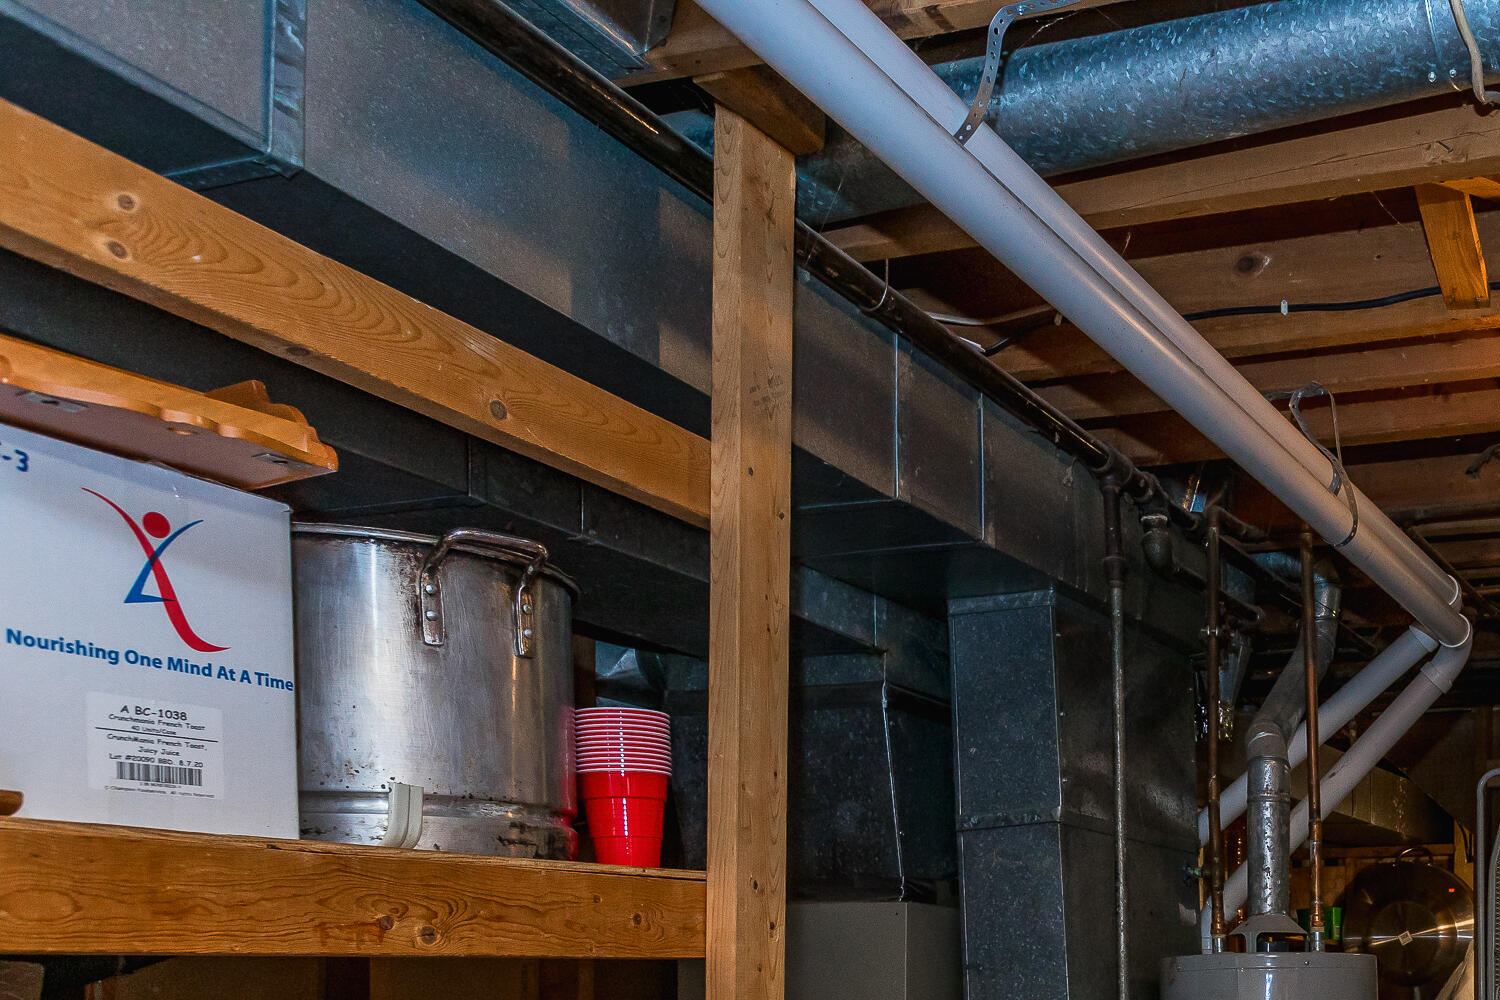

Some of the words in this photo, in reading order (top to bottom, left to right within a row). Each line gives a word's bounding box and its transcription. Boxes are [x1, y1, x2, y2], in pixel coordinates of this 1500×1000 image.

[0, 449, 30, 472] -3
[6, 628, 120, 665] Nourishing
[124, 649, 163, 668] One
[167, 656, 213, 677] Mind
[216, 666, 236, 682] At
[239, 670, 251, 684] A
[254, 672, 294, 691] Time
[120, 705, 129, 713] A
[135, 706, 187, 720] BC-1038
[158, 720, 182, 728] French
[157, 739, 181, 747] French
